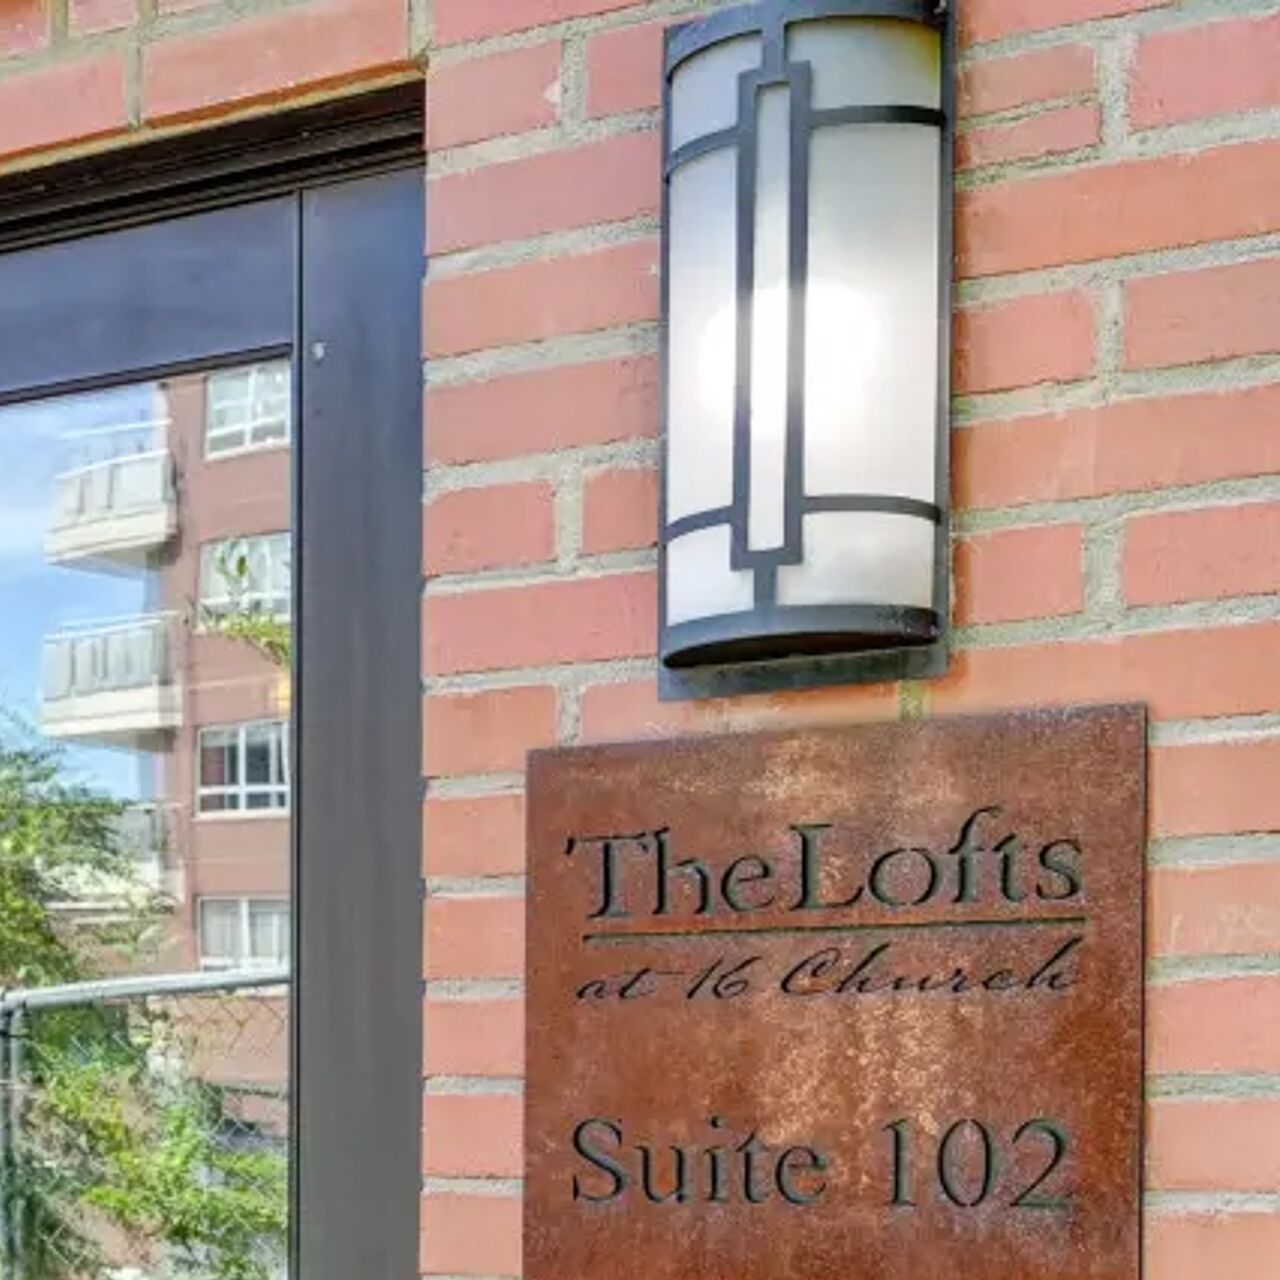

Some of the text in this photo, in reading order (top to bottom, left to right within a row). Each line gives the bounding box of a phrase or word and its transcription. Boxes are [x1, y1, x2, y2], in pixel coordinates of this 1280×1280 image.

[575, 935, 1084, 1000] at 16 Church
[571, 1111, 1076, 1212] Suite 102
